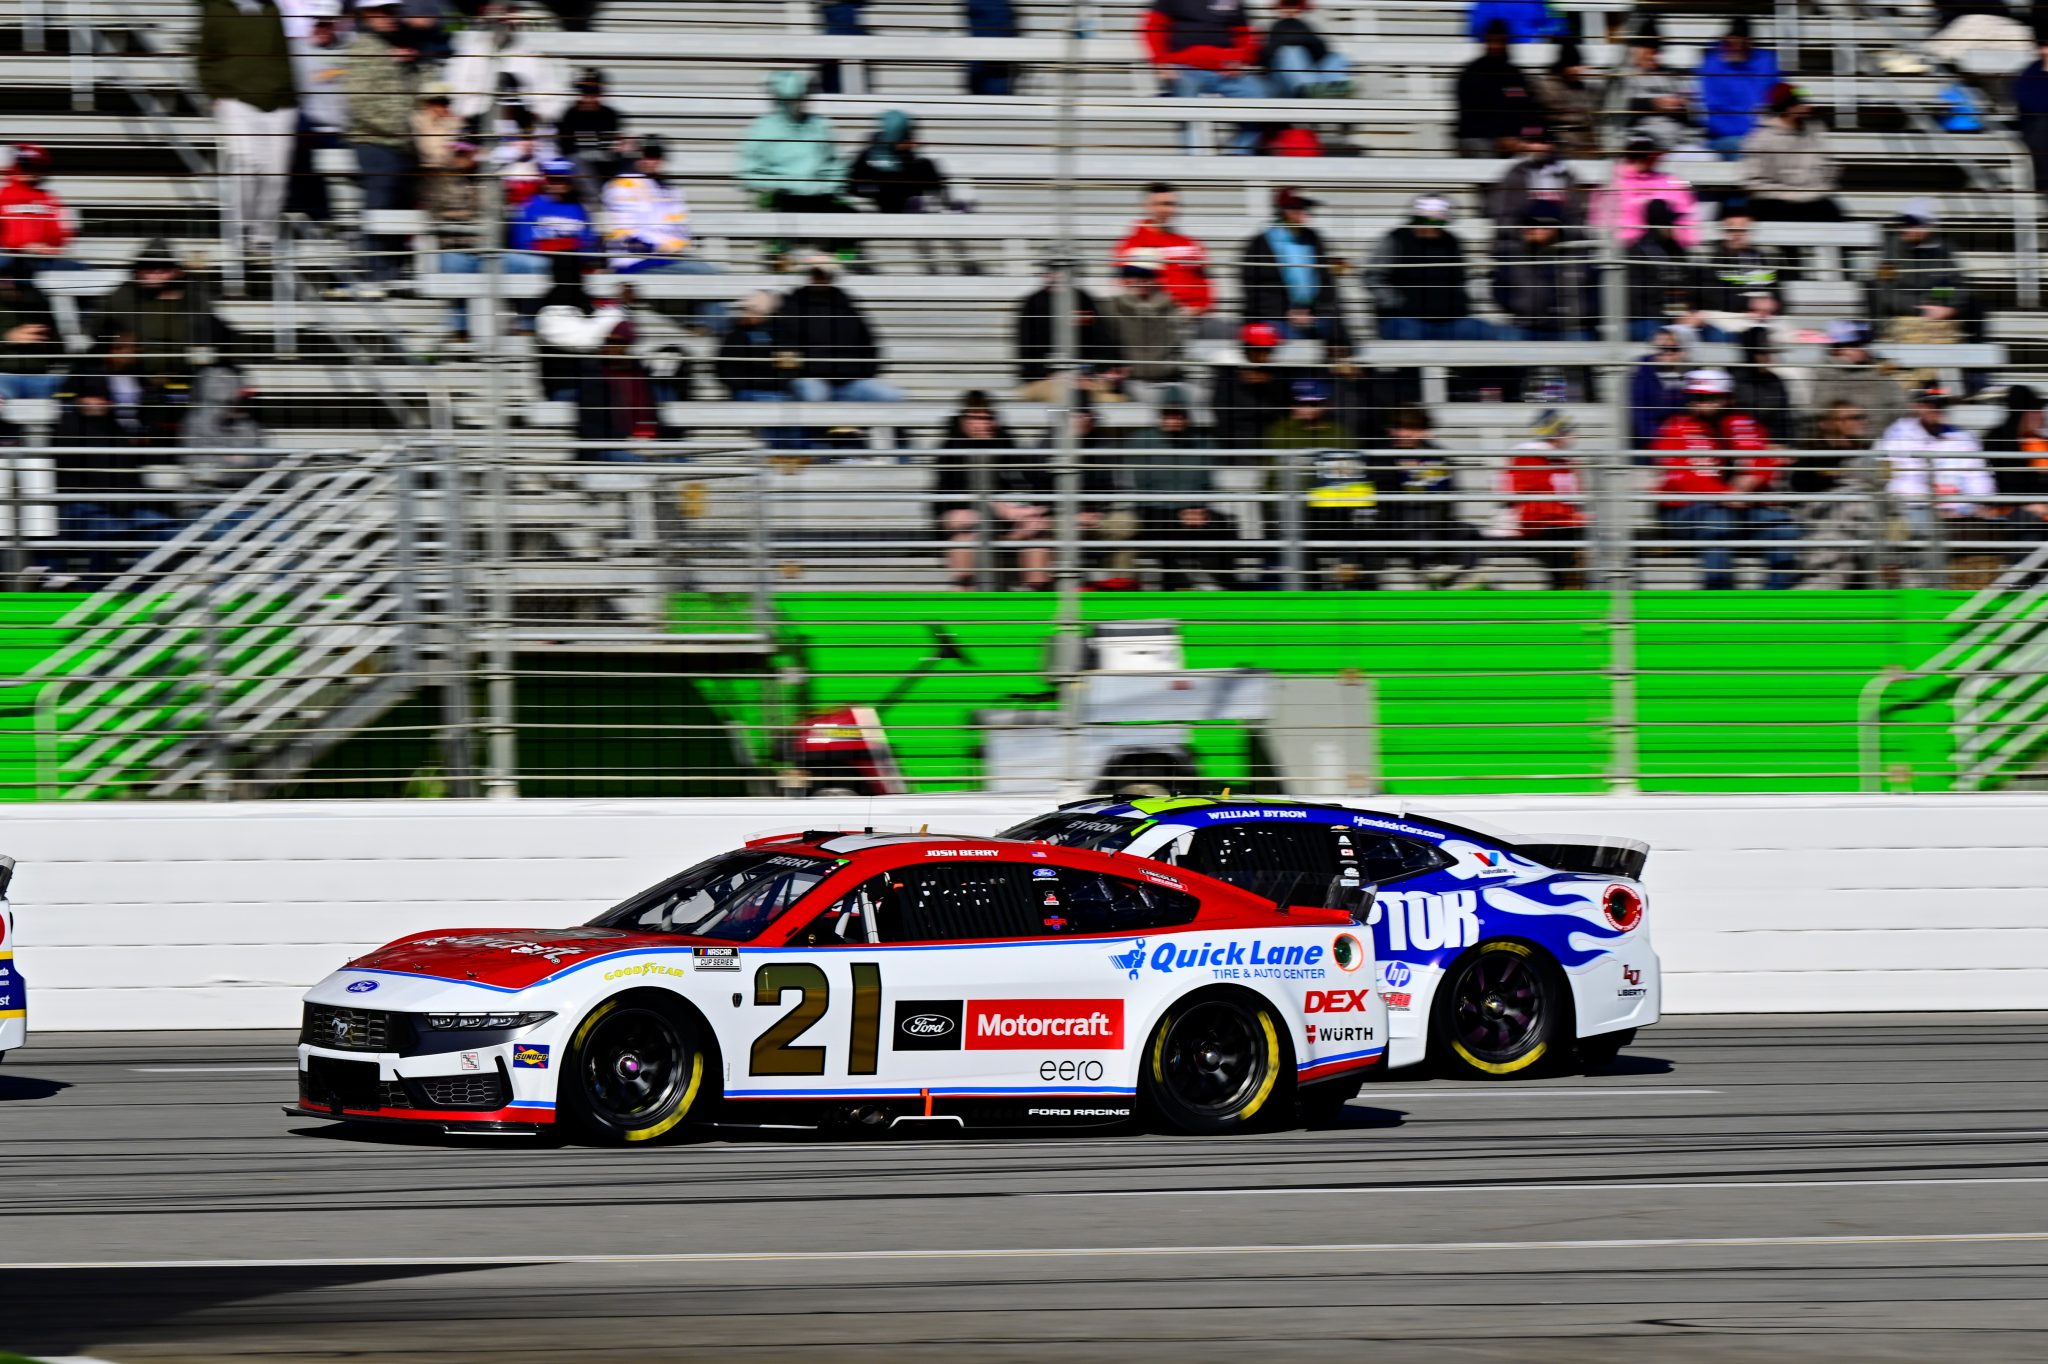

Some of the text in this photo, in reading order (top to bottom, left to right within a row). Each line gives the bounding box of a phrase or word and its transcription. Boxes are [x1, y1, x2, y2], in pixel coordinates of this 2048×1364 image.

[1207, 810, 1308, 820] WILLIAM BYRON
[1065, 820, 1123, 833] BYRON
[1353, 815, 1446, 840] HendrickCars.com
[924, 849, 1000, 857] JOSH BERRY
[765, 855, 820, 869] BERRY
[707, 948, 733, 956] NASCAR
[1150, 940, 1324, 973] Quick Lane
[700, 958, 734, 966] CUP SERIES
[603, 962, 684, 981] GOODYEAR
[1212, 968, 1326, 980] TIRE & AUTO CENTER
[1386, 961, 1411, 987] hp
[1617, 988, 1648, 997] LIBERTY
[1304, 989, 1369, 1014] DEX
[749, 962, 882, 1077] 21
[910, 1016, 945, 1033] Ford
[977, 1012, 1112, 1036] Motorcraft
[515, 1053, 549, 1061] SUNOCO
[1039, 1060, 1104, 1081] eero
[1028, 1108, 1130, 1116] FORD RACING
